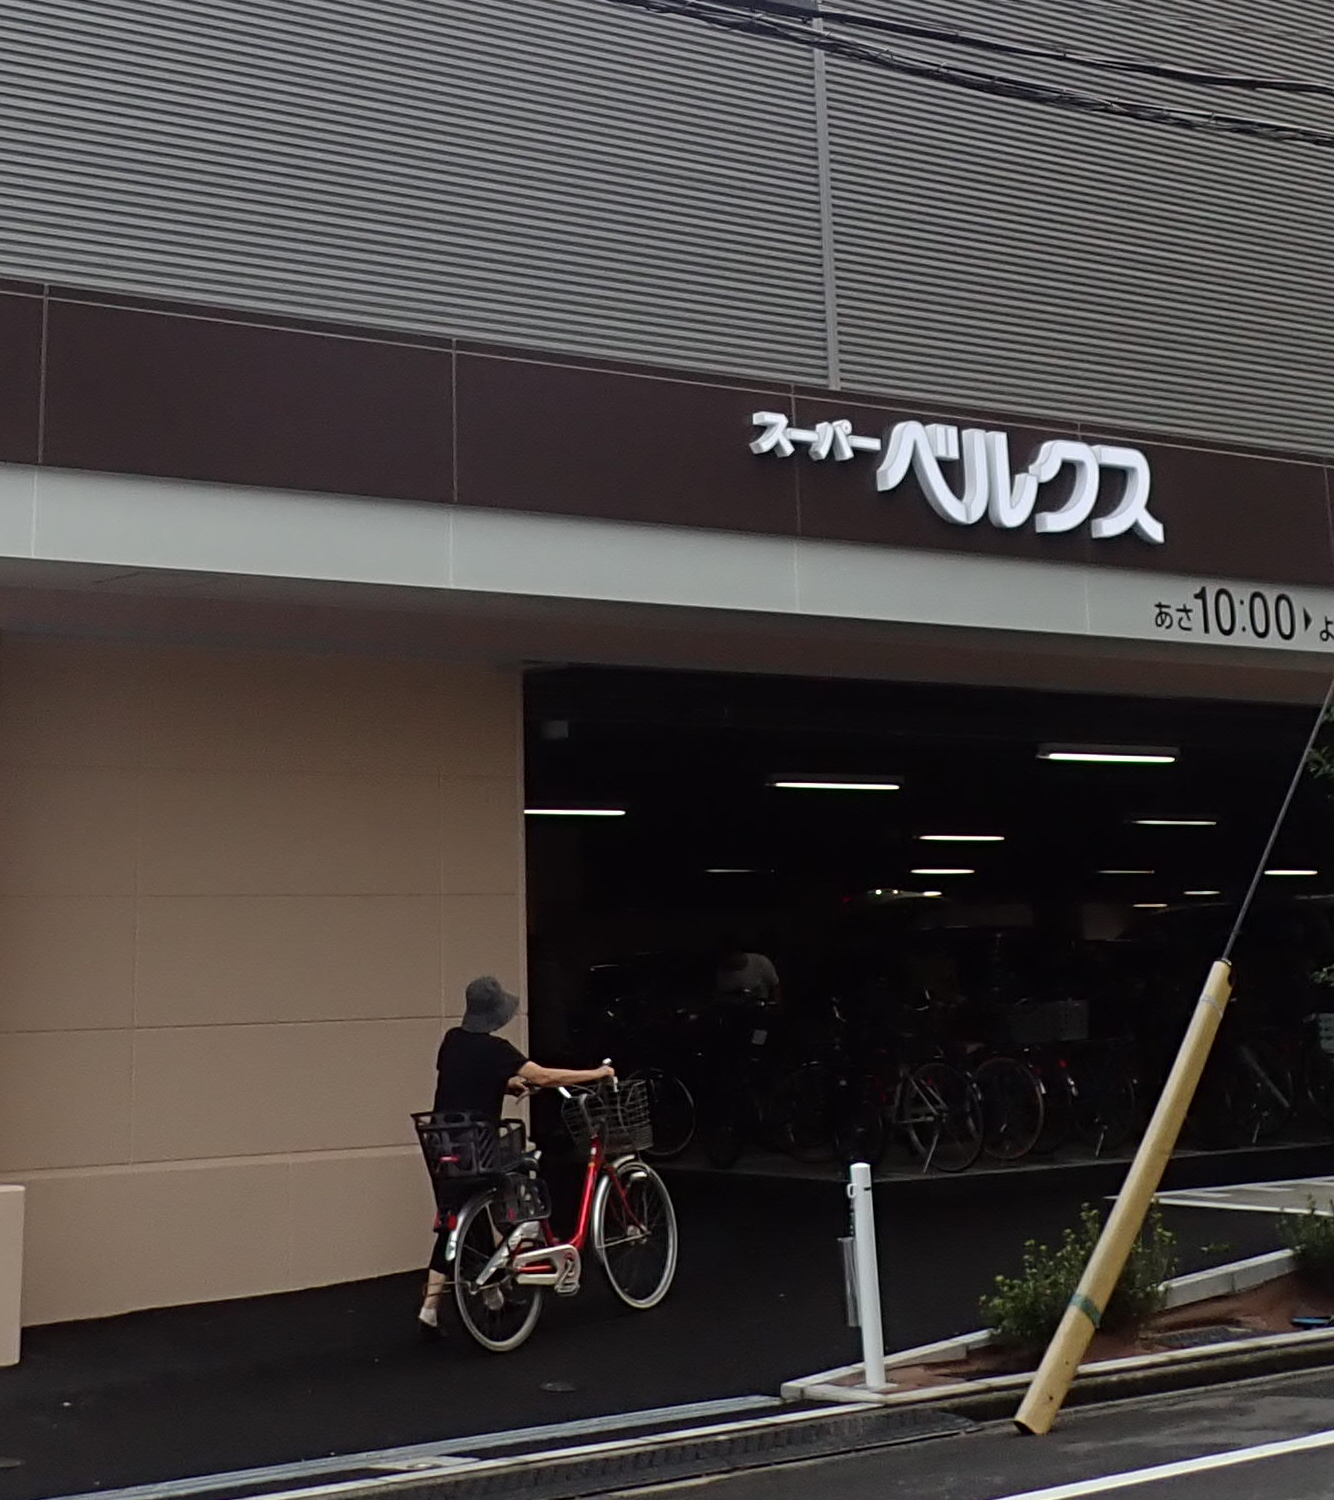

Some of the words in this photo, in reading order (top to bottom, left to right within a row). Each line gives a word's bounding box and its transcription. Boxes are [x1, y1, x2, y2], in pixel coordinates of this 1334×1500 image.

[749, 411, 881, 460] スーパー
[876, 420, 1165, 544] ベルクス
